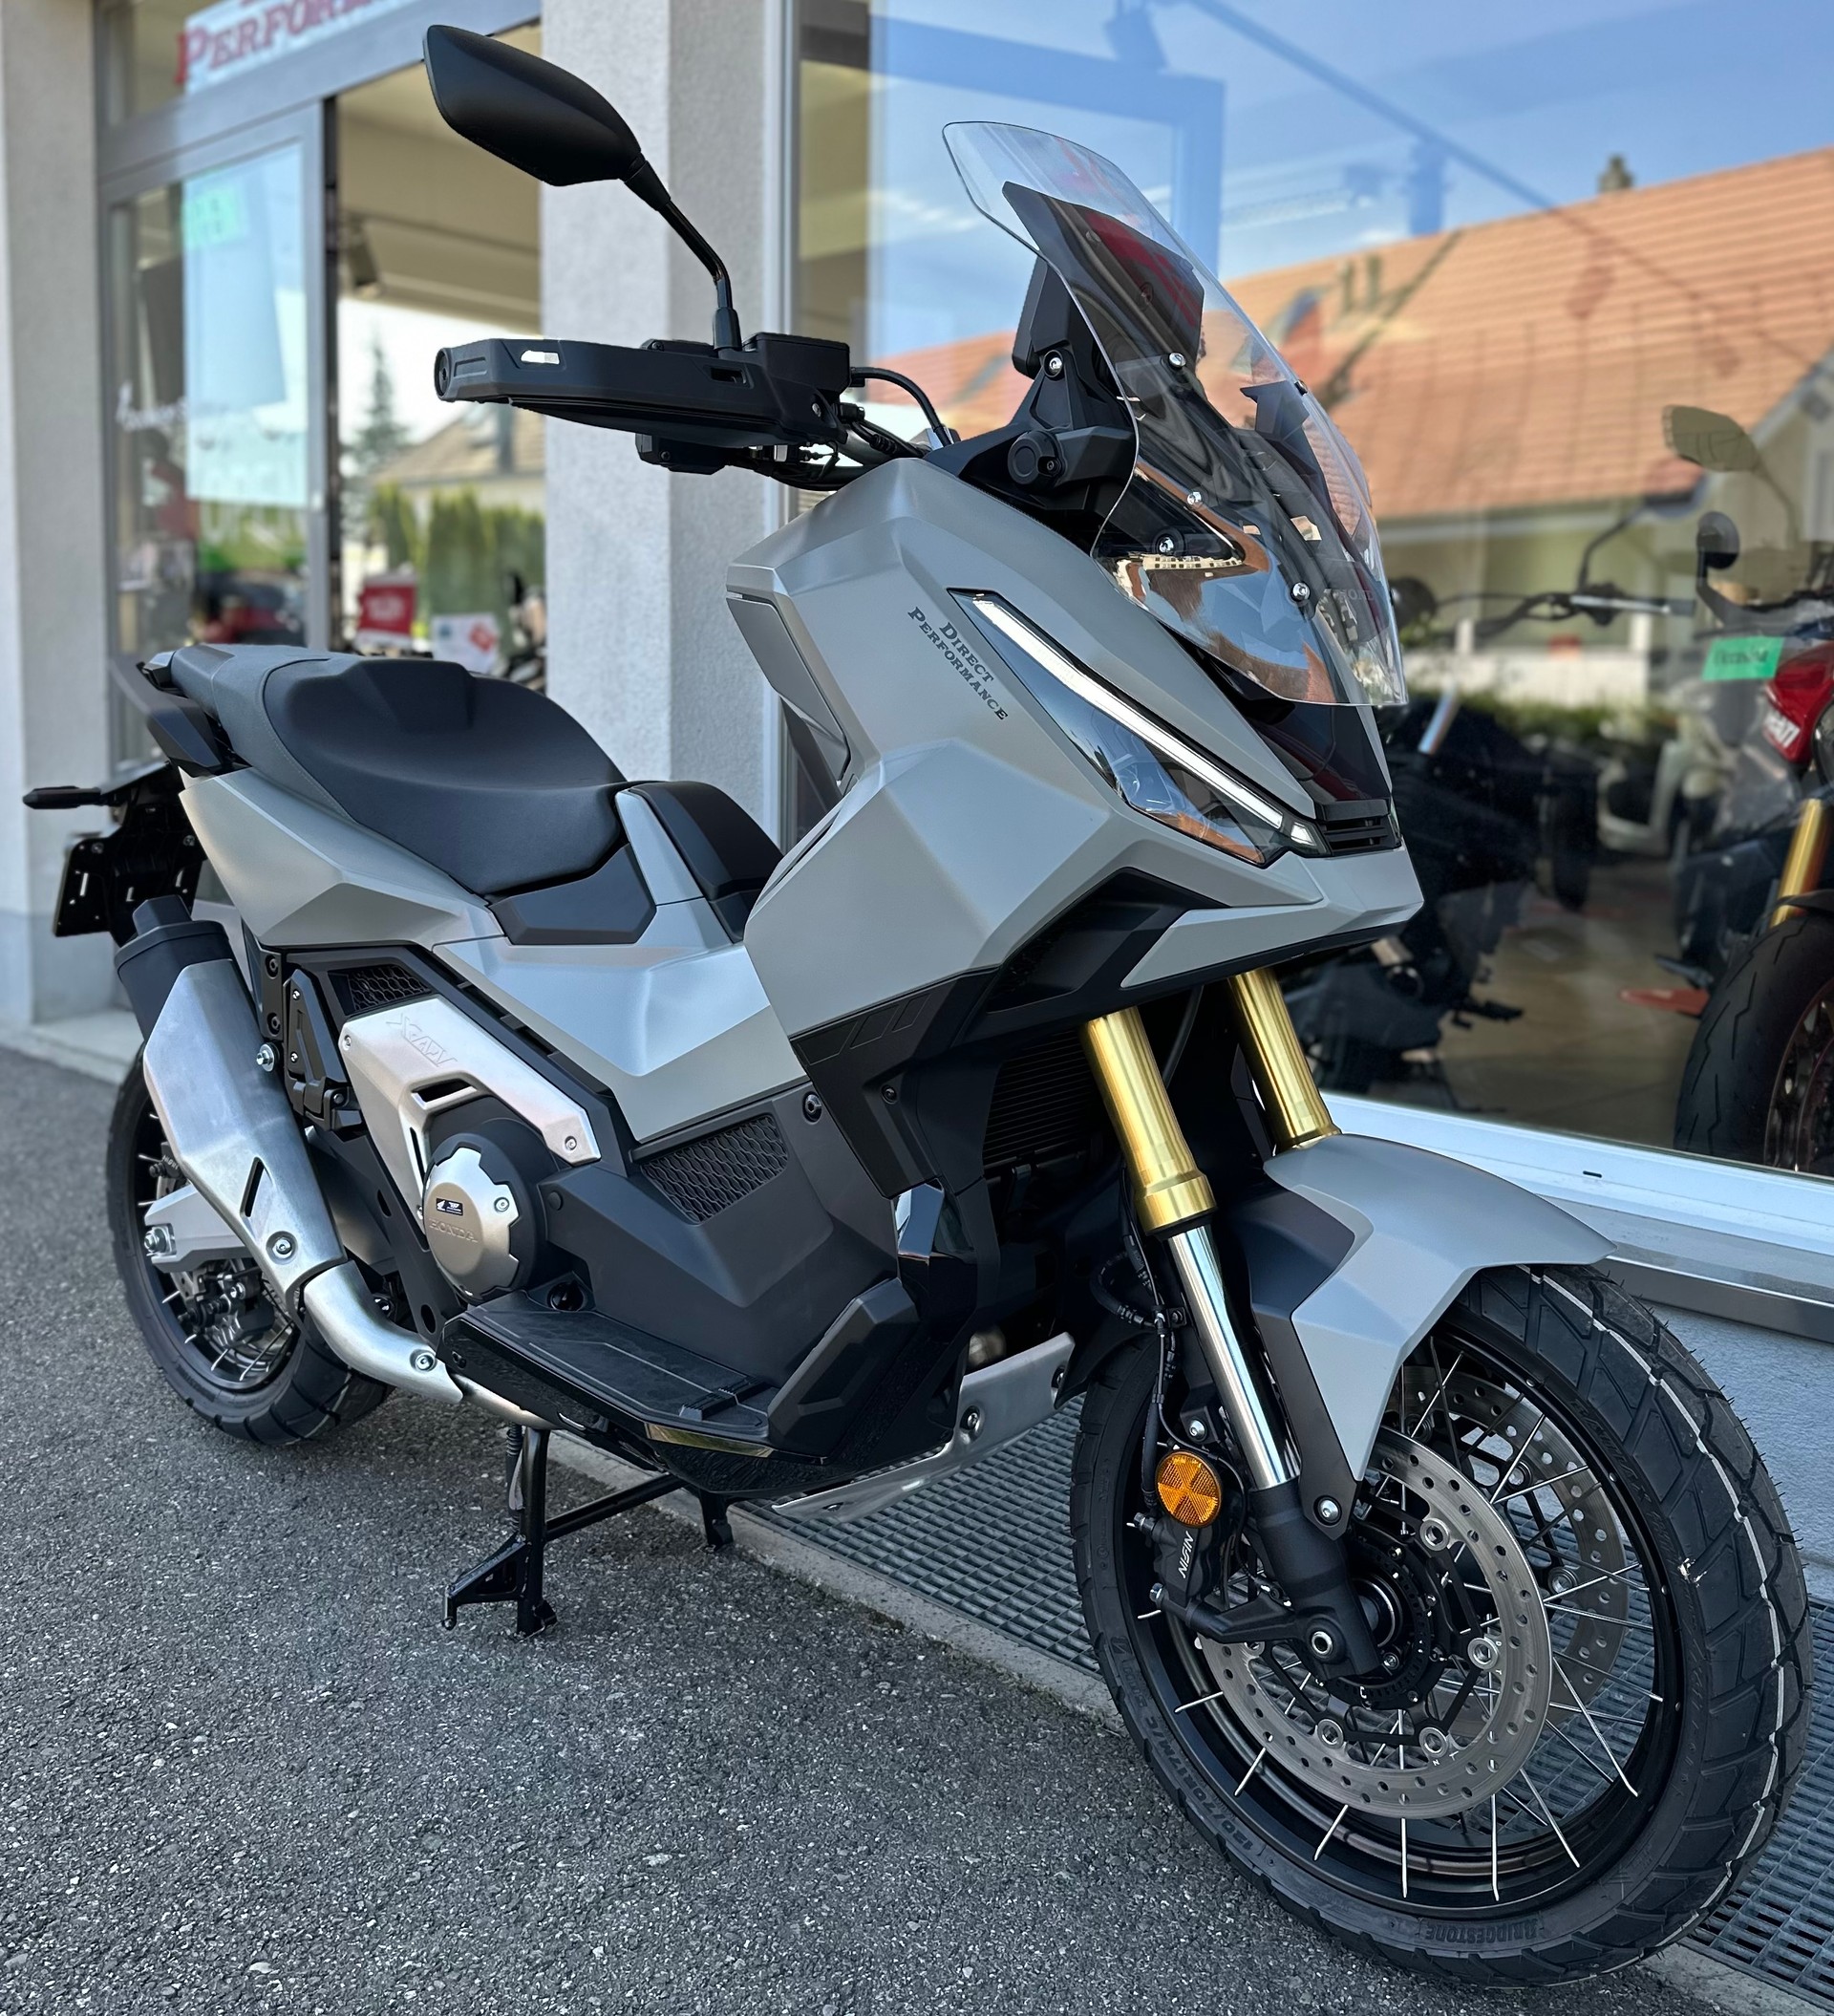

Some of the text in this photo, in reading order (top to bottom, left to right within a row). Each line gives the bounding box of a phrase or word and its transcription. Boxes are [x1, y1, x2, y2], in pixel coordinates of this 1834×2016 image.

[907, 607, 1009, 720] PERFORMANCE
[939, 622, 994, 682] DIRECT
[428, 1217, 479, 1243] HONDA
[1178, 1530, 1194, 1579] NISSIN
[1425, 1918, 1538, 1945] BRIDGESTONE
